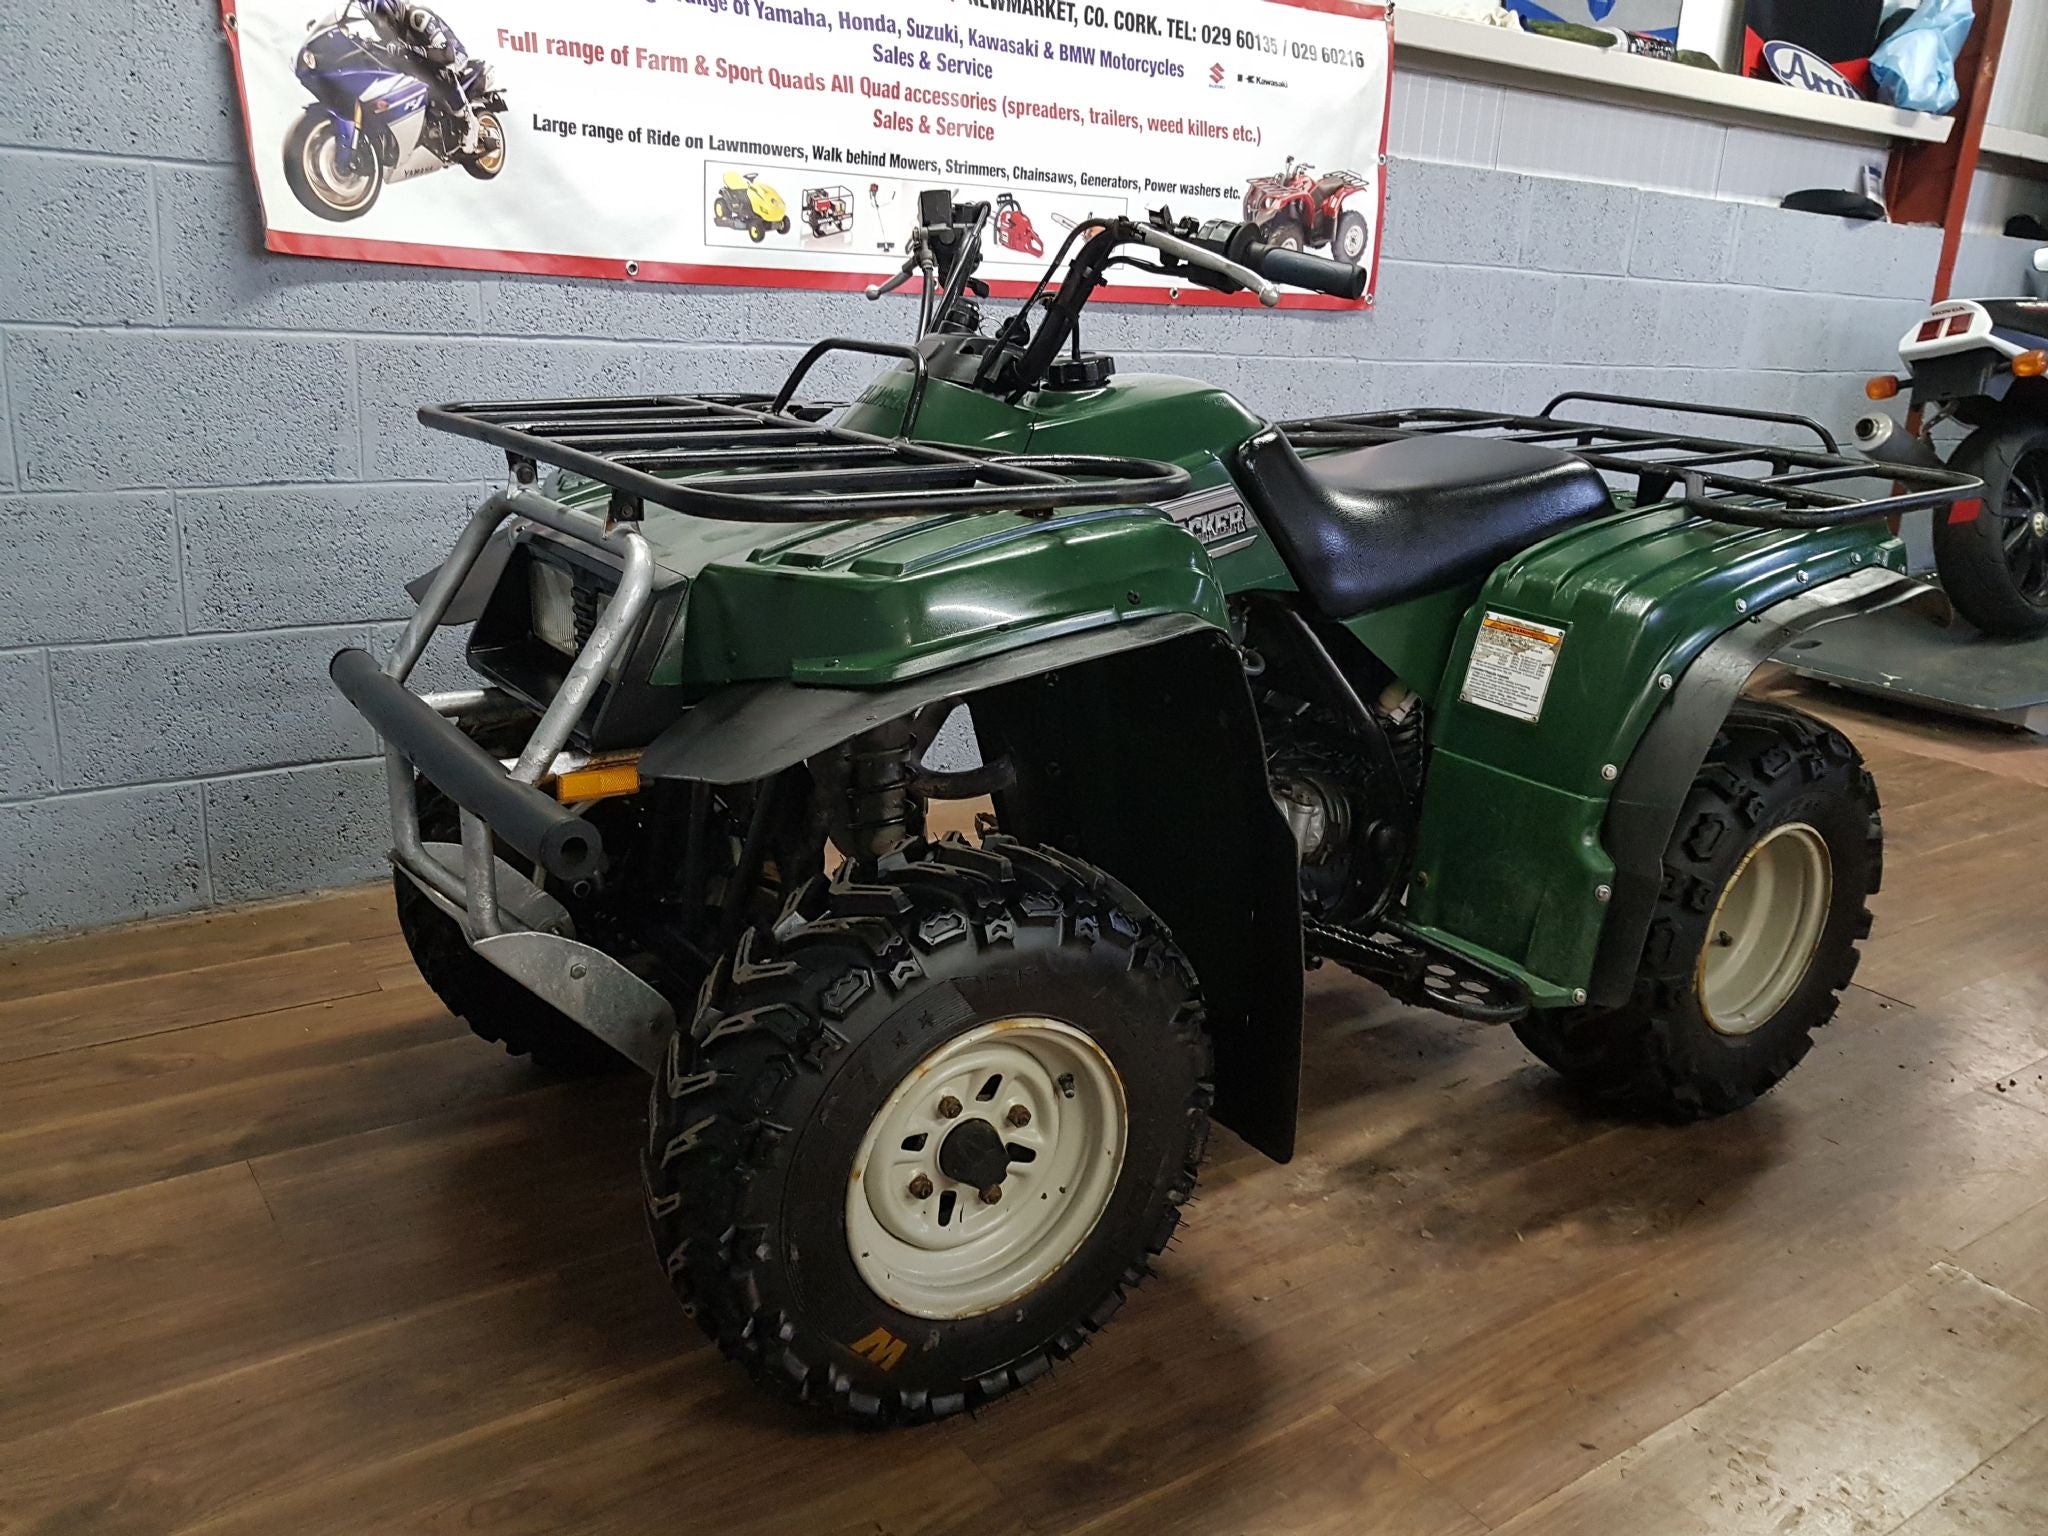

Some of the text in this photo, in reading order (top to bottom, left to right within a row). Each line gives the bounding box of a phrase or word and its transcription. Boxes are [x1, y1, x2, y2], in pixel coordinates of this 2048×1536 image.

[733, 0, 750, 17] of
[756, 0, 832, 32] Yamaha,
[839, 11, 902, 38] Honda,
[906, 17, 964, 48] Suzuki,
[968, 28, 1039, 57] Kawasaki
[1044, 41, 1054, 60] &
[1059, 43, 1096, 66] BMW
[1100, 49, 1184, 78] Motorcycles
[873, 43, 993, 79] Sales & Service
[967, 0, 1365, 68] WMARKET, CO. CORK. TEL: 029 60135 / 029 60216
[497, 28, 1262, 147] Full range of Farm & Sport Quads All Quad accessories (spreaders, trailers, weed killers etc.)
[533, 113, 1241, 200] Large range of Ride on Lawnmowers, Walk behind Mowers, Strimmers, Chainsaws, Generators, Power washers etc.
[873, 108, 994, 141] Sales & Service
[1182, 503, 1247, 545] CKER
